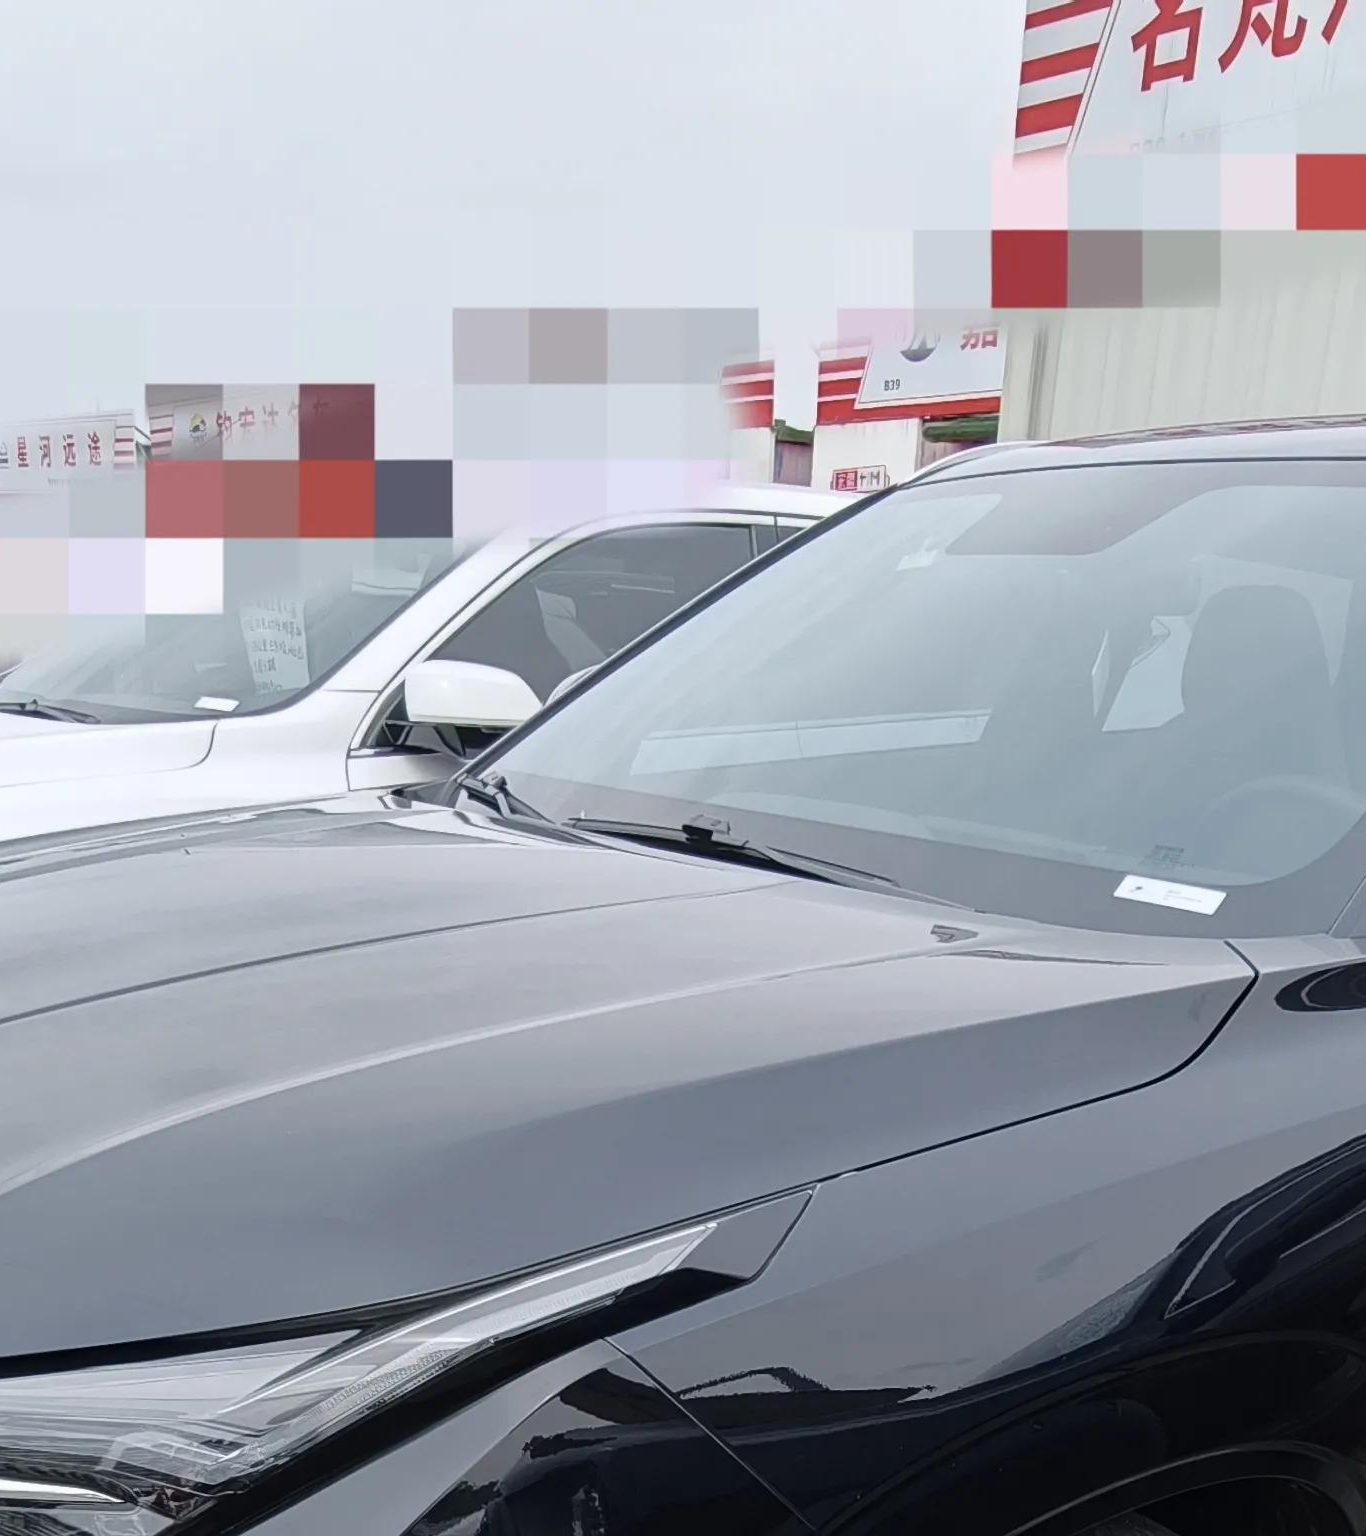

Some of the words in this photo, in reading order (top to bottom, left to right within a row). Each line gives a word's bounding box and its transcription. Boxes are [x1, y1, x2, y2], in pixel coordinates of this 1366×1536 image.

[883, 378, 901, 391] B39
[16, 431, 102, 468] 星河远途
